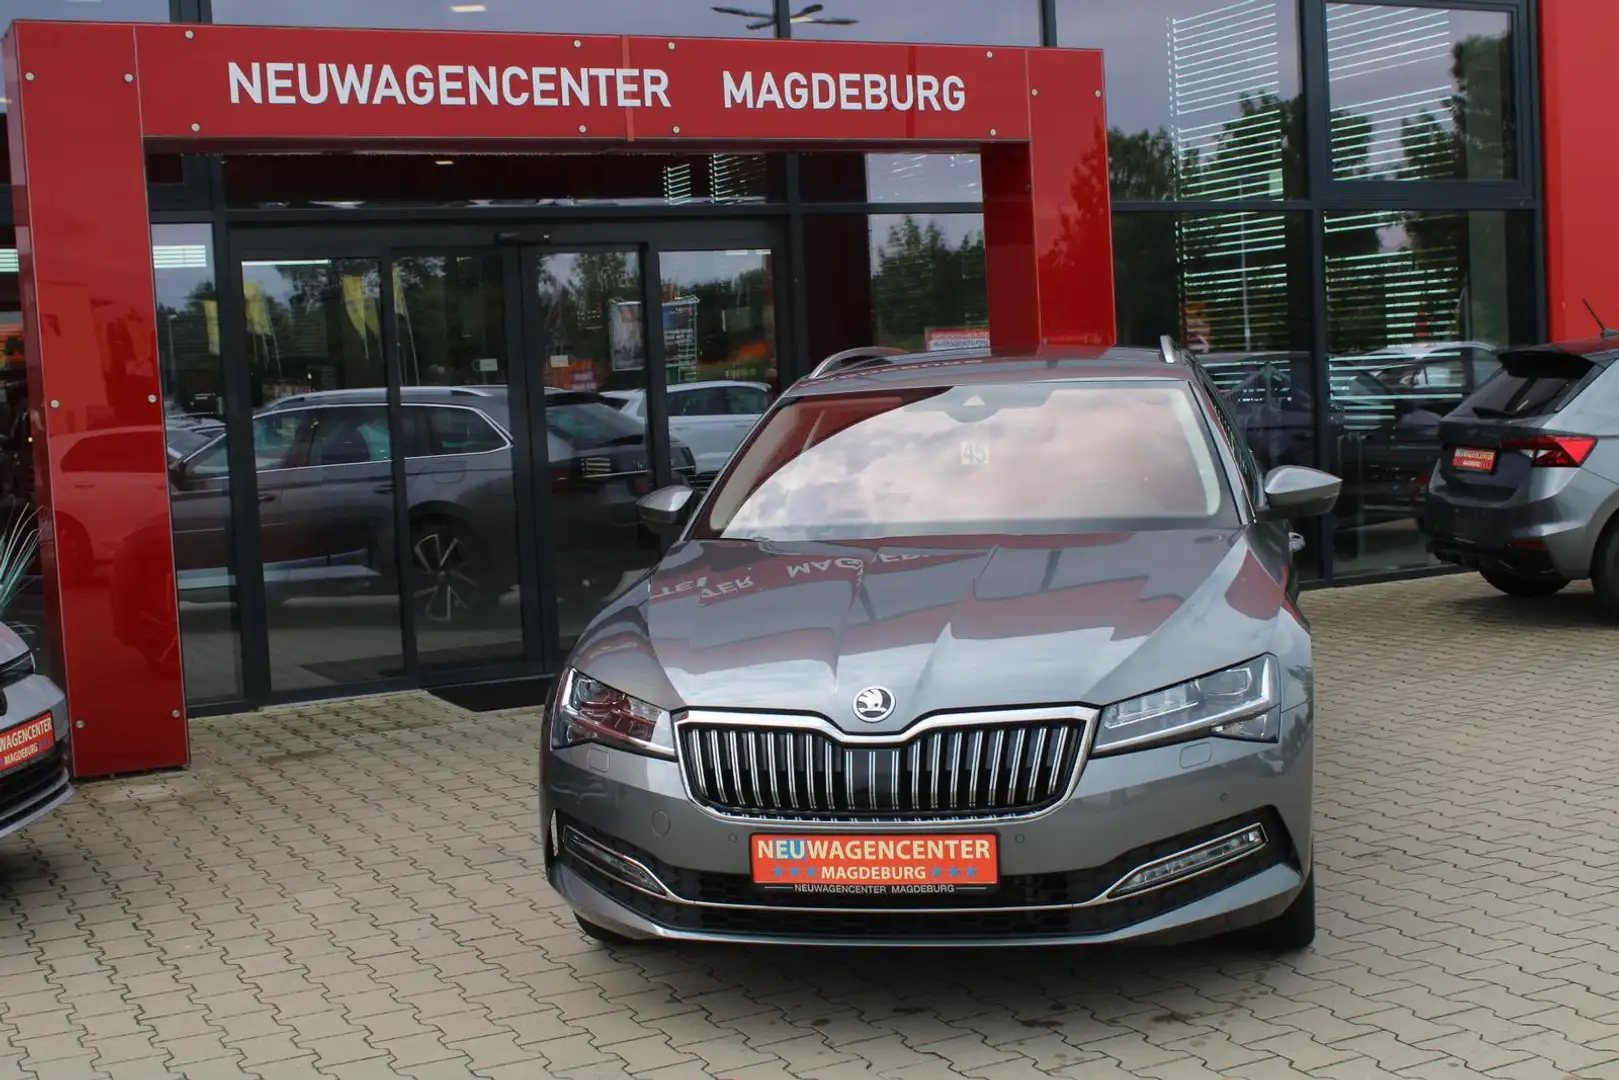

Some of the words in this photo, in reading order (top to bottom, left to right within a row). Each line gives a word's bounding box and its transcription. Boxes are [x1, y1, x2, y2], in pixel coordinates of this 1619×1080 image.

[228, 61, 671, 108] NEUWAGENCENTER
[722, 70, 966, 112] MAGDEBURG
[4, 743, 38, 766] MAGDEBURG
[757, 839, 991, 861] NEUWAGENCENTER
[821, 866, 927, 880] MAGDEBURG
[794, 883, 887, 894] NEUWAGENCENTER
[891, 884, 955, 894] MAGDEBURG
